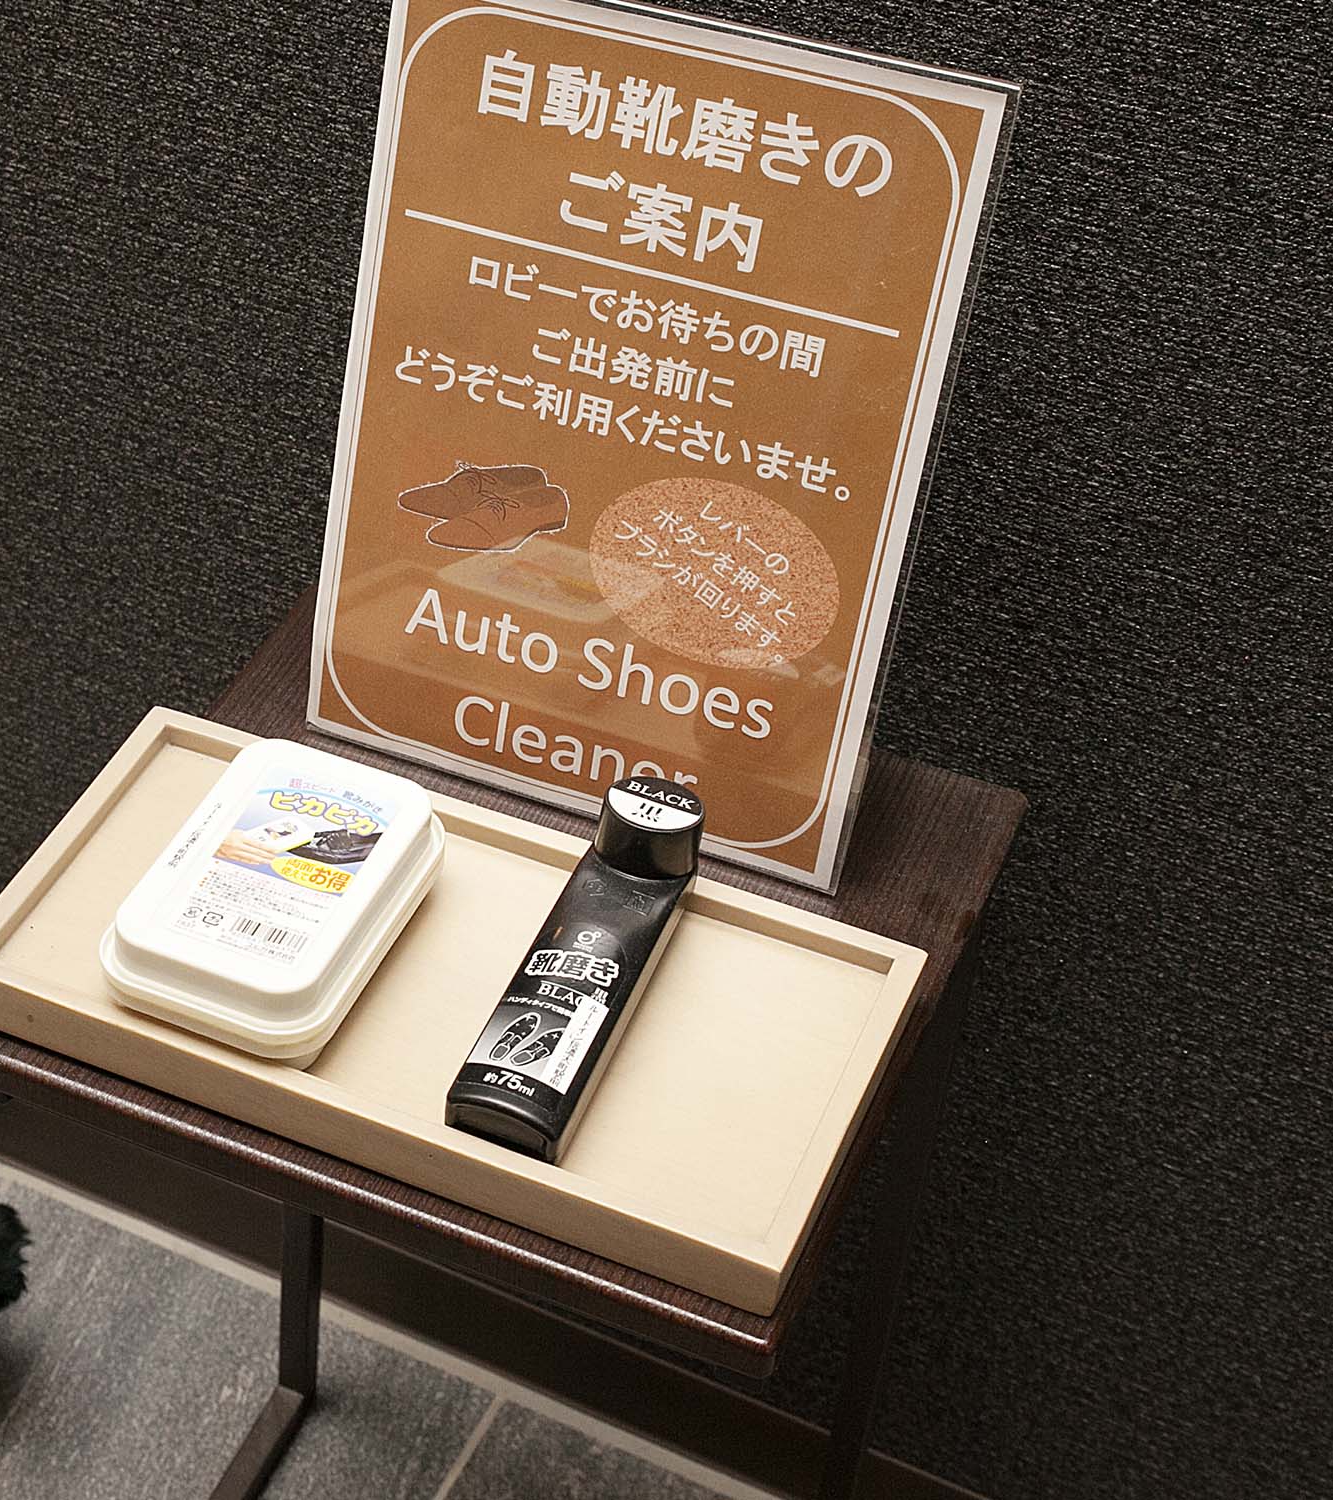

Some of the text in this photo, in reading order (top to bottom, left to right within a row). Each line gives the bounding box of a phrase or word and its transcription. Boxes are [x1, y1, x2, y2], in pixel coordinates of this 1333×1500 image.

[476, 50, 893, 198] 自動靴磨きの
[559, 169, 764, 273] ご案内
[468, 256, 826, 378] ロビーでお待ちの間
[531, 327, 735, 409] ご出発前に
[394, 344, 852, 501] どうぞご利用くださいませ。
[653, 509, 796, 626] ボタンを押すと
[700, 501, 789, 575] レバーの
[615, 520, 783, 663] ブラシが回ります。
[404, 588, 775, 740] Auto Shoes
[269, 790, 379, 837] ピカピカ
[626, 780, 695, 810] BLACK
[308, 866, 351, 891] お得
[524, 950, 619, 987] 靴磨き
[483, 1070, 535, 1097] 約75ml
